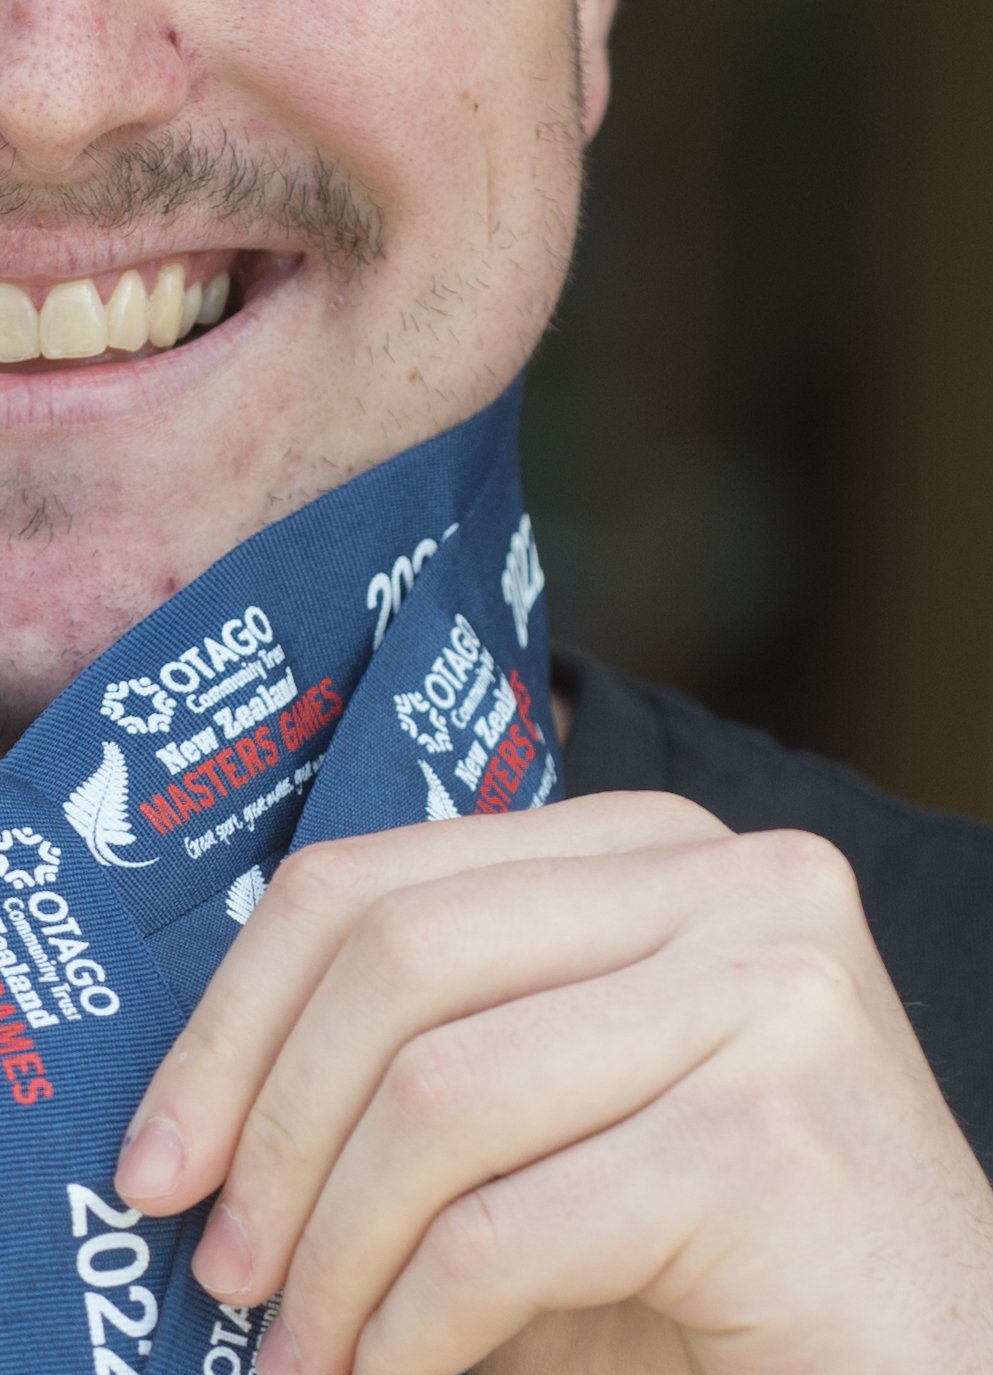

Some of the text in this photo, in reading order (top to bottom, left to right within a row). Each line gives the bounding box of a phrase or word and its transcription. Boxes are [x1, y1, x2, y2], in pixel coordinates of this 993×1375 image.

[160, 606, 273, 693] OTAGO
[186, 661, 268, 713] Community
[424, 613, 481, 710] OTAGO
[139, 678, 343, 835] MASTERS GAMES
[156, 666, 298, 775] New Zealand
[454, 739, 488, 792] New
[473, 724, 536, 816] ASTERS
[3, 897, 81, 1020] Community Trust
[28, 891, 120, 1017] OTAGO
